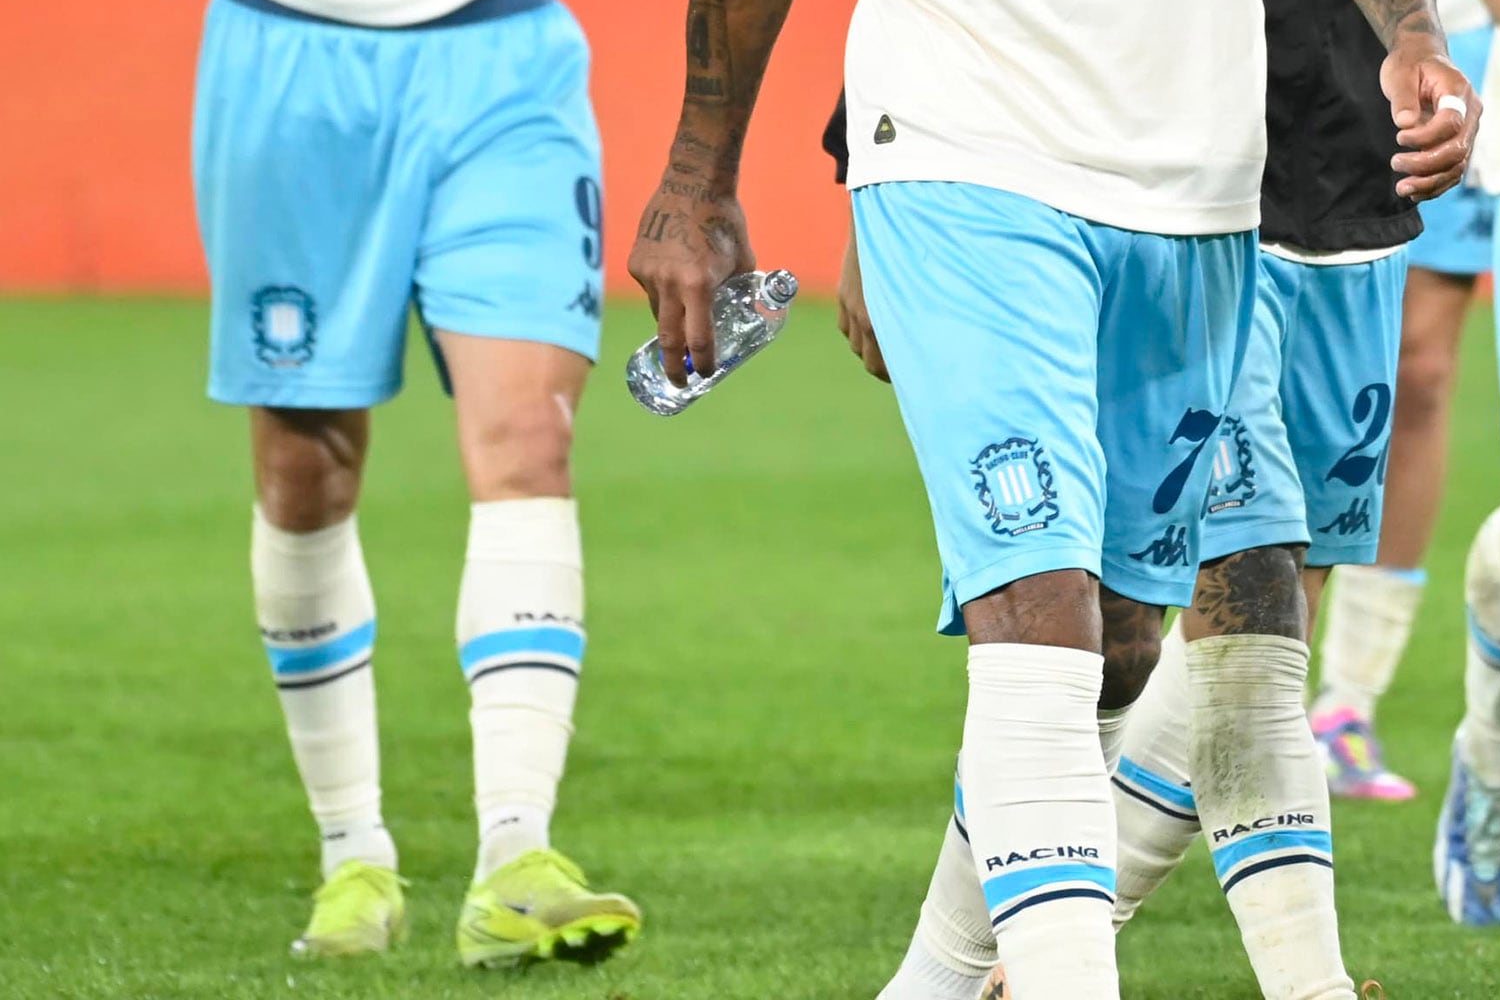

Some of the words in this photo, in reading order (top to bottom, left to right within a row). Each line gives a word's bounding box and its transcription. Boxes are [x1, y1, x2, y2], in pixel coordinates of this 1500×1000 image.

[575, 176, 603, 270] 9
[1153, 407, 1222, 515] 7
[1213, 813, 1314, 842] RACING
[986, 846, 1099, 871] RACING
